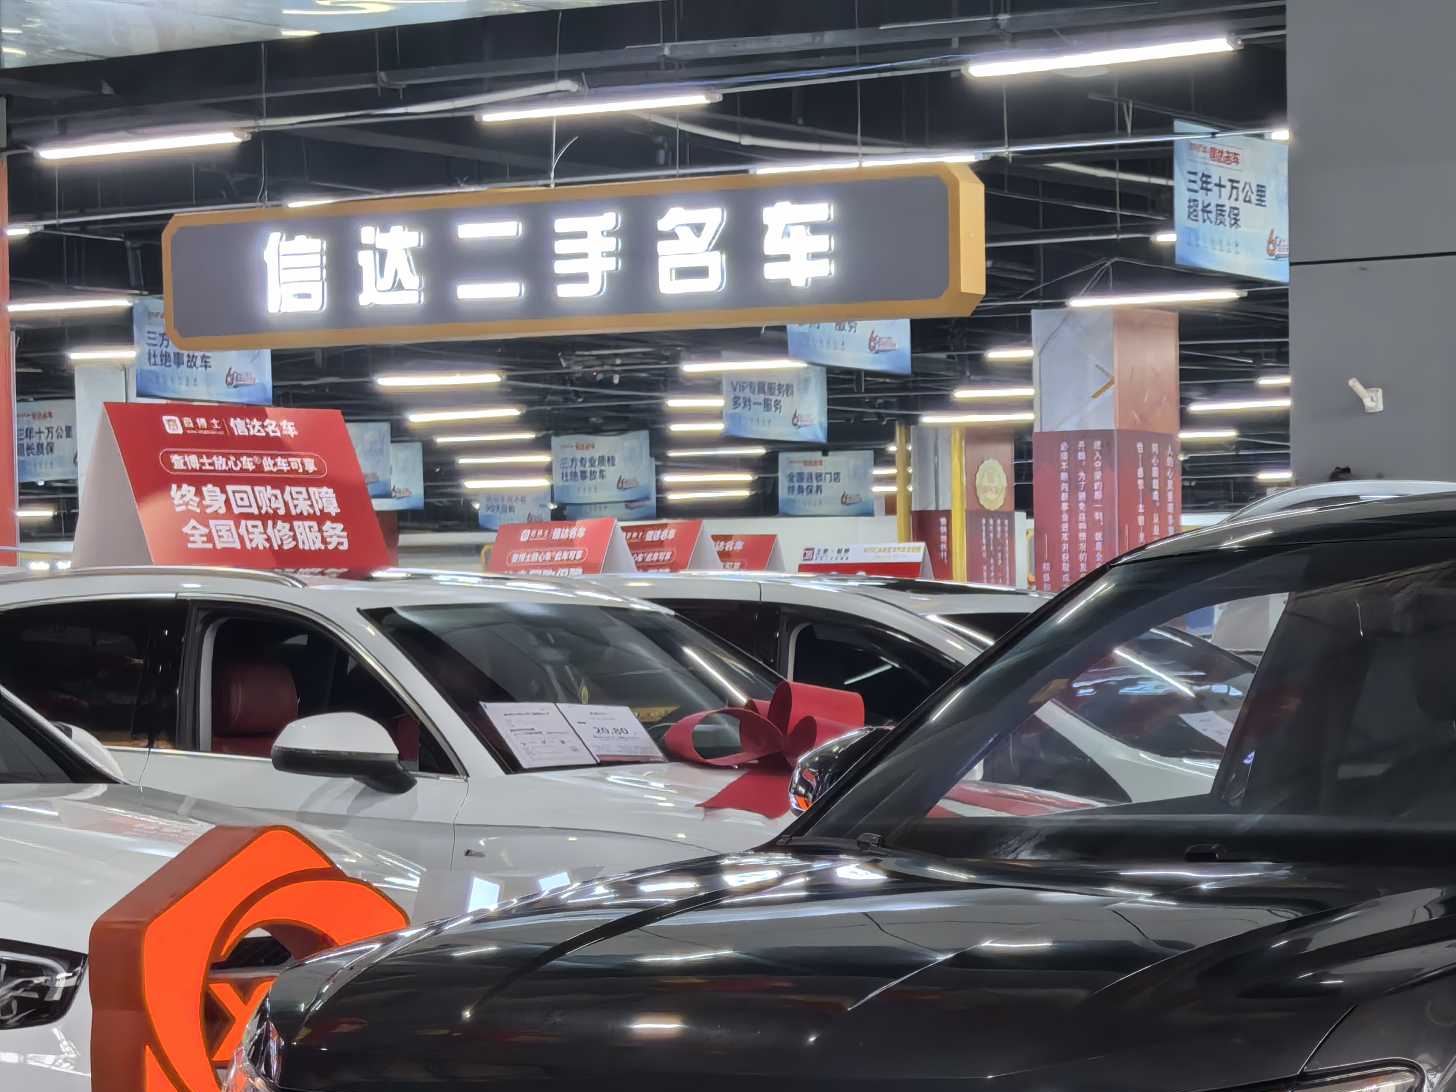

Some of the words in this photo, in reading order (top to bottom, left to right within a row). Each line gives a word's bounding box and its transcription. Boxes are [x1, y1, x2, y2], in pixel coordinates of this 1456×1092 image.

[1186, 170, 1268, 208] 三年十万公里
[1186, 198, 1242, 230] 超长质保
[264, 201, 836, 314] 信达二手名车
[230, 418, 298, 439] 信达名车
[170, 484, 341, 516] 终身回购保障
[182, 519, 350, 551] 全国保修服务
